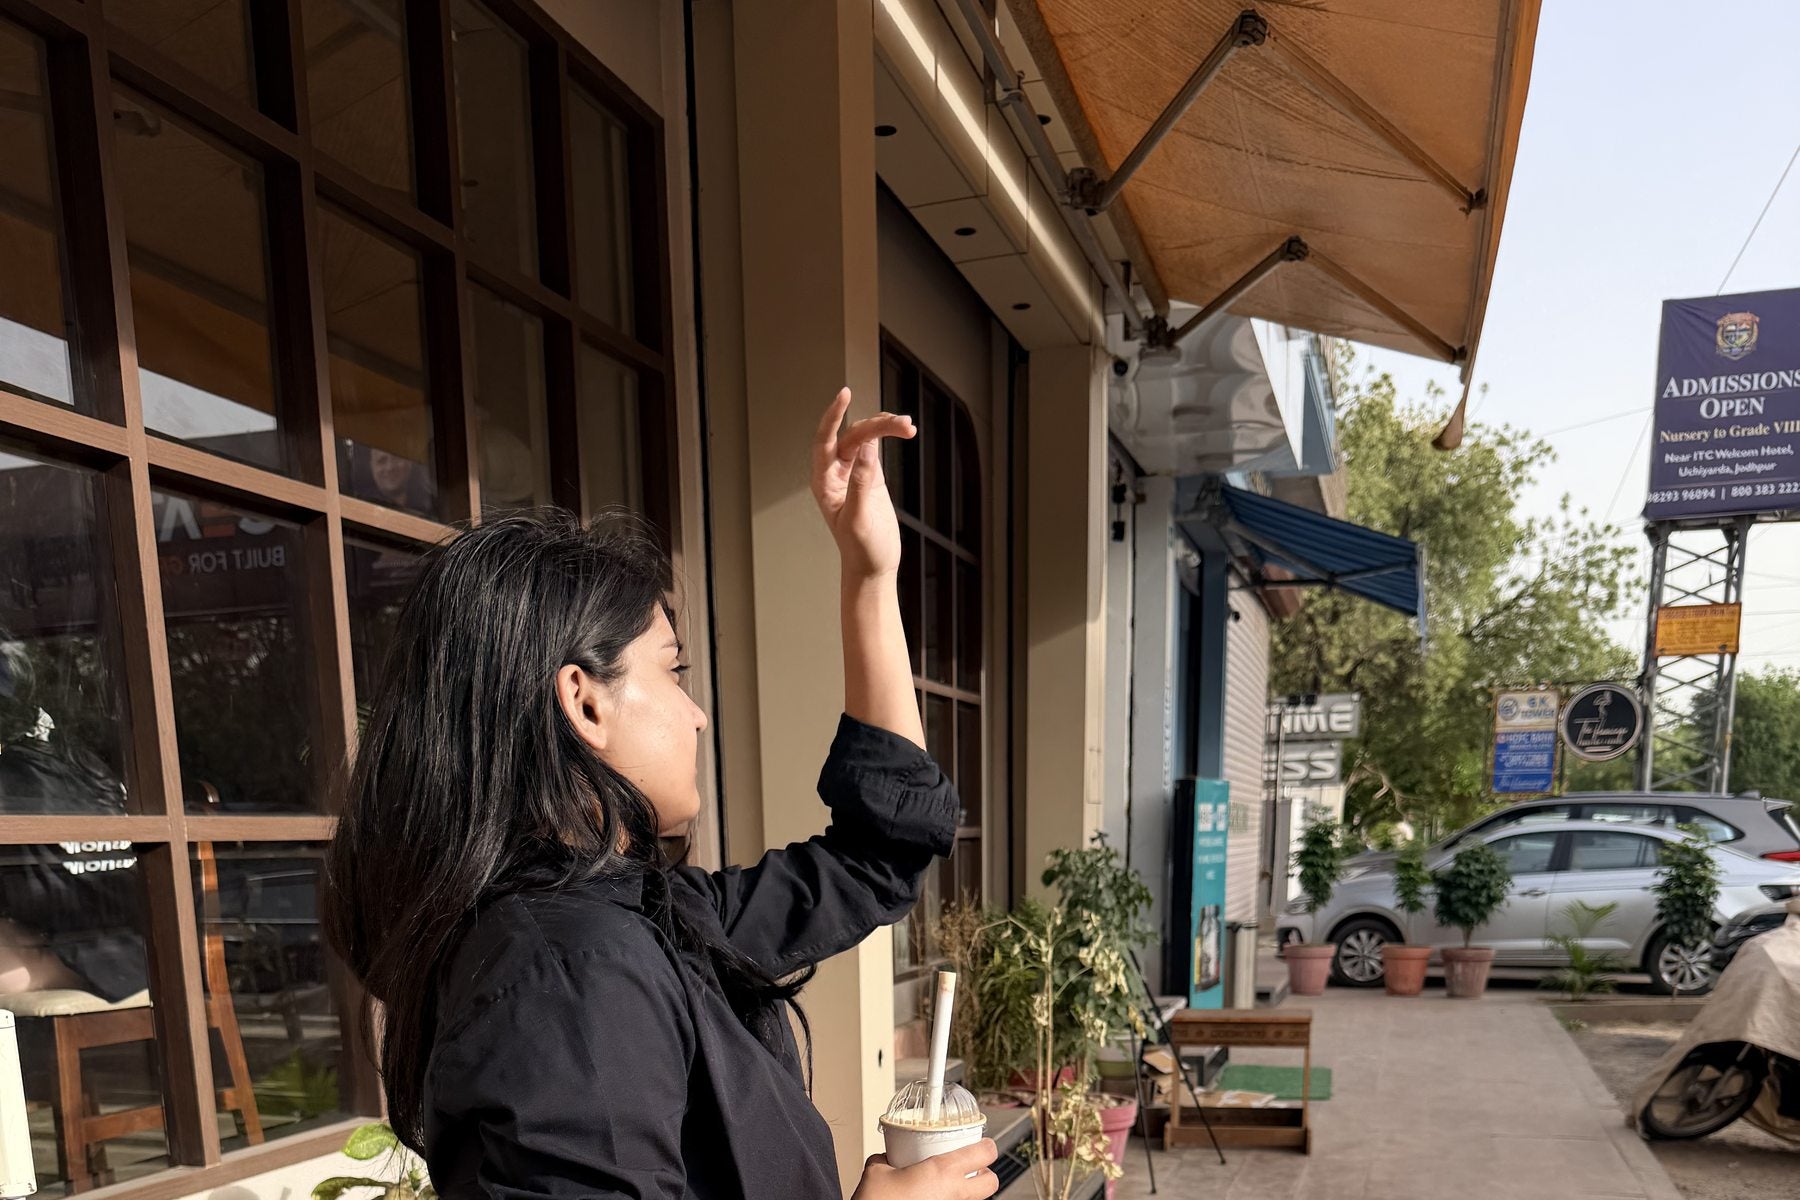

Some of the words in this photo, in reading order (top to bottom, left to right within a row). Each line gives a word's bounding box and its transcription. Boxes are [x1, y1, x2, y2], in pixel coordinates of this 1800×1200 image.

[1662, 369, 1800, 399] ADMISSIONS
[1699, 396, 1766, 420] OPEN
[1659, 429, 1711, 443] Nursery
[1713, 427, 1727, 439] to
[1729, 422, 1771, 438] Grade
[1664, 452, 1693, 464] Near
[1693, 449, 1715, 461] ITC
[1777, 480, 1800, 494] 222
